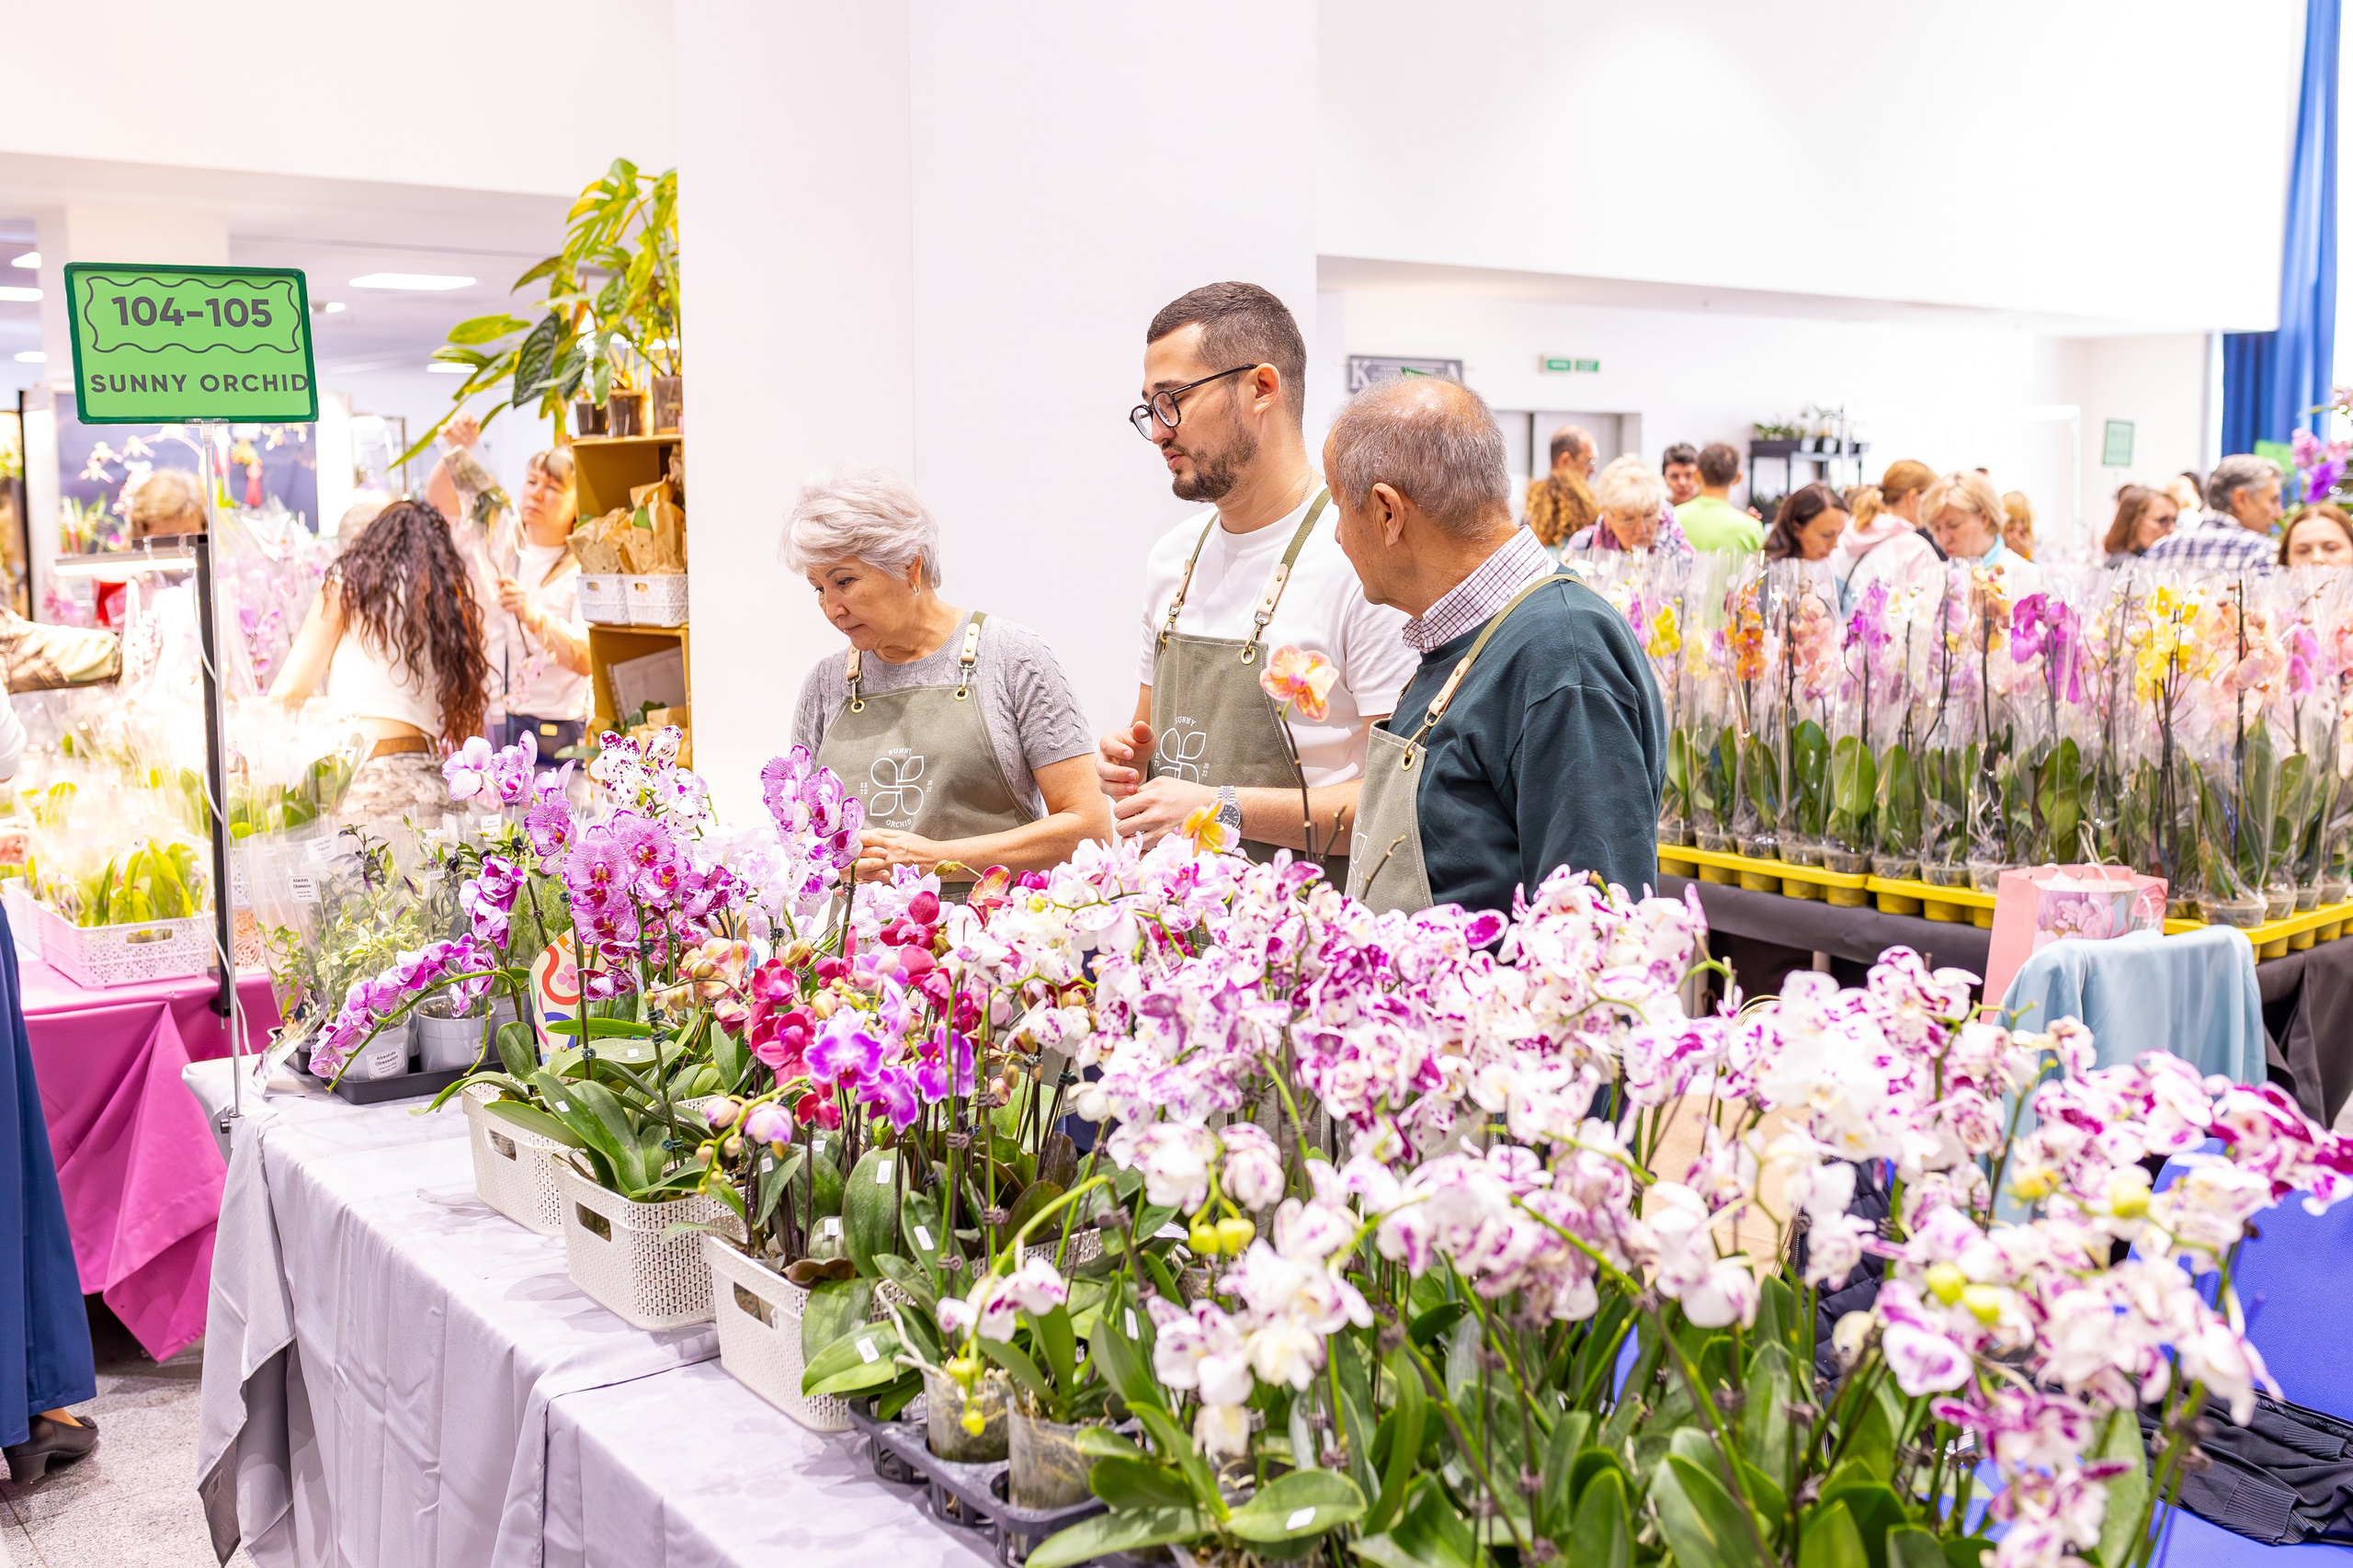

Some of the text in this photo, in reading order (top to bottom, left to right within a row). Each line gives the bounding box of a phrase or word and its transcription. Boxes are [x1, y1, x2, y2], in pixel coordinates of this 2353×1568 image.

[110, 296, 272, 328] 104-105
[90, 373, 309, 393] SUNNY ORCHID
[1175, 716, 1196, 727] SUNNY
[885, 818, 912, 828] ORCHID
